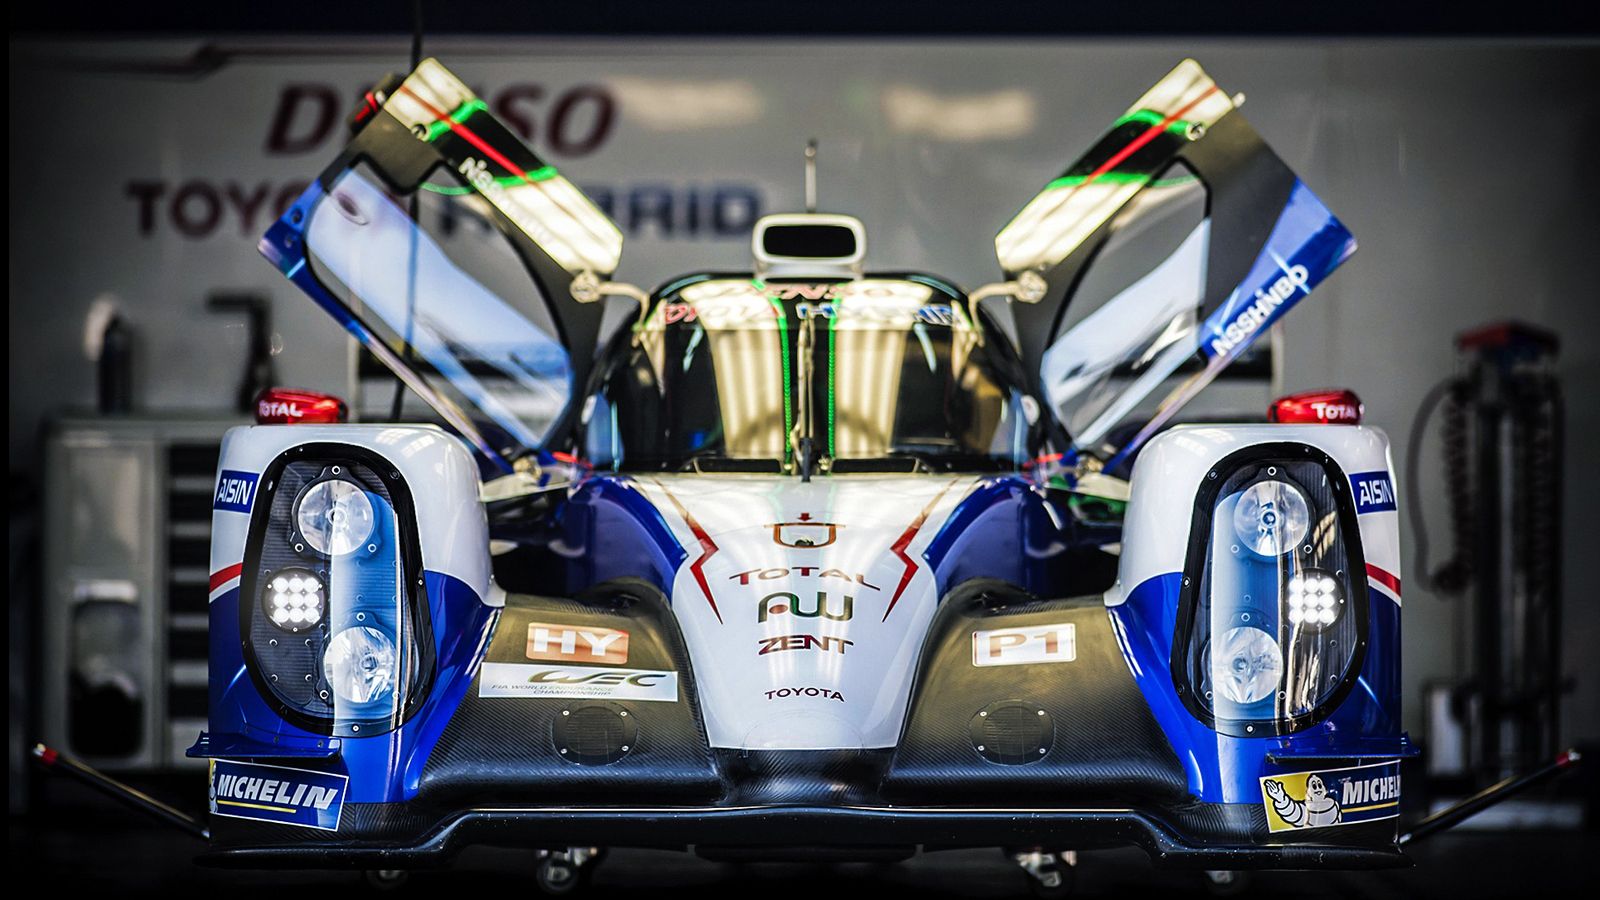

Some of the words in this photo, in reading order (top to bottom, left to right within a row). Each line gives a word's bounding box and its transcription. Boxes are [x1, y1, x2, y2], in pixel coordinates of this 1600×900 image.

[264, 82, 618, 156] DSO
[259, 401, 303, 418] TOTAL
[216, 478, 253, 506] AISIN
[1358, 479, 1394, 507] AISIN
[728, 566, 881, 592] TOTAL
[533, 627, 623, 657] HY
[758, 634, 854, 656] ZENT
[988, 631, 1058, 658] P1
[528, 670, 667, 687] WEC
[764, 687, 845, 702] TOYOTA
[217, 773, 339, 811] MICHELIN
